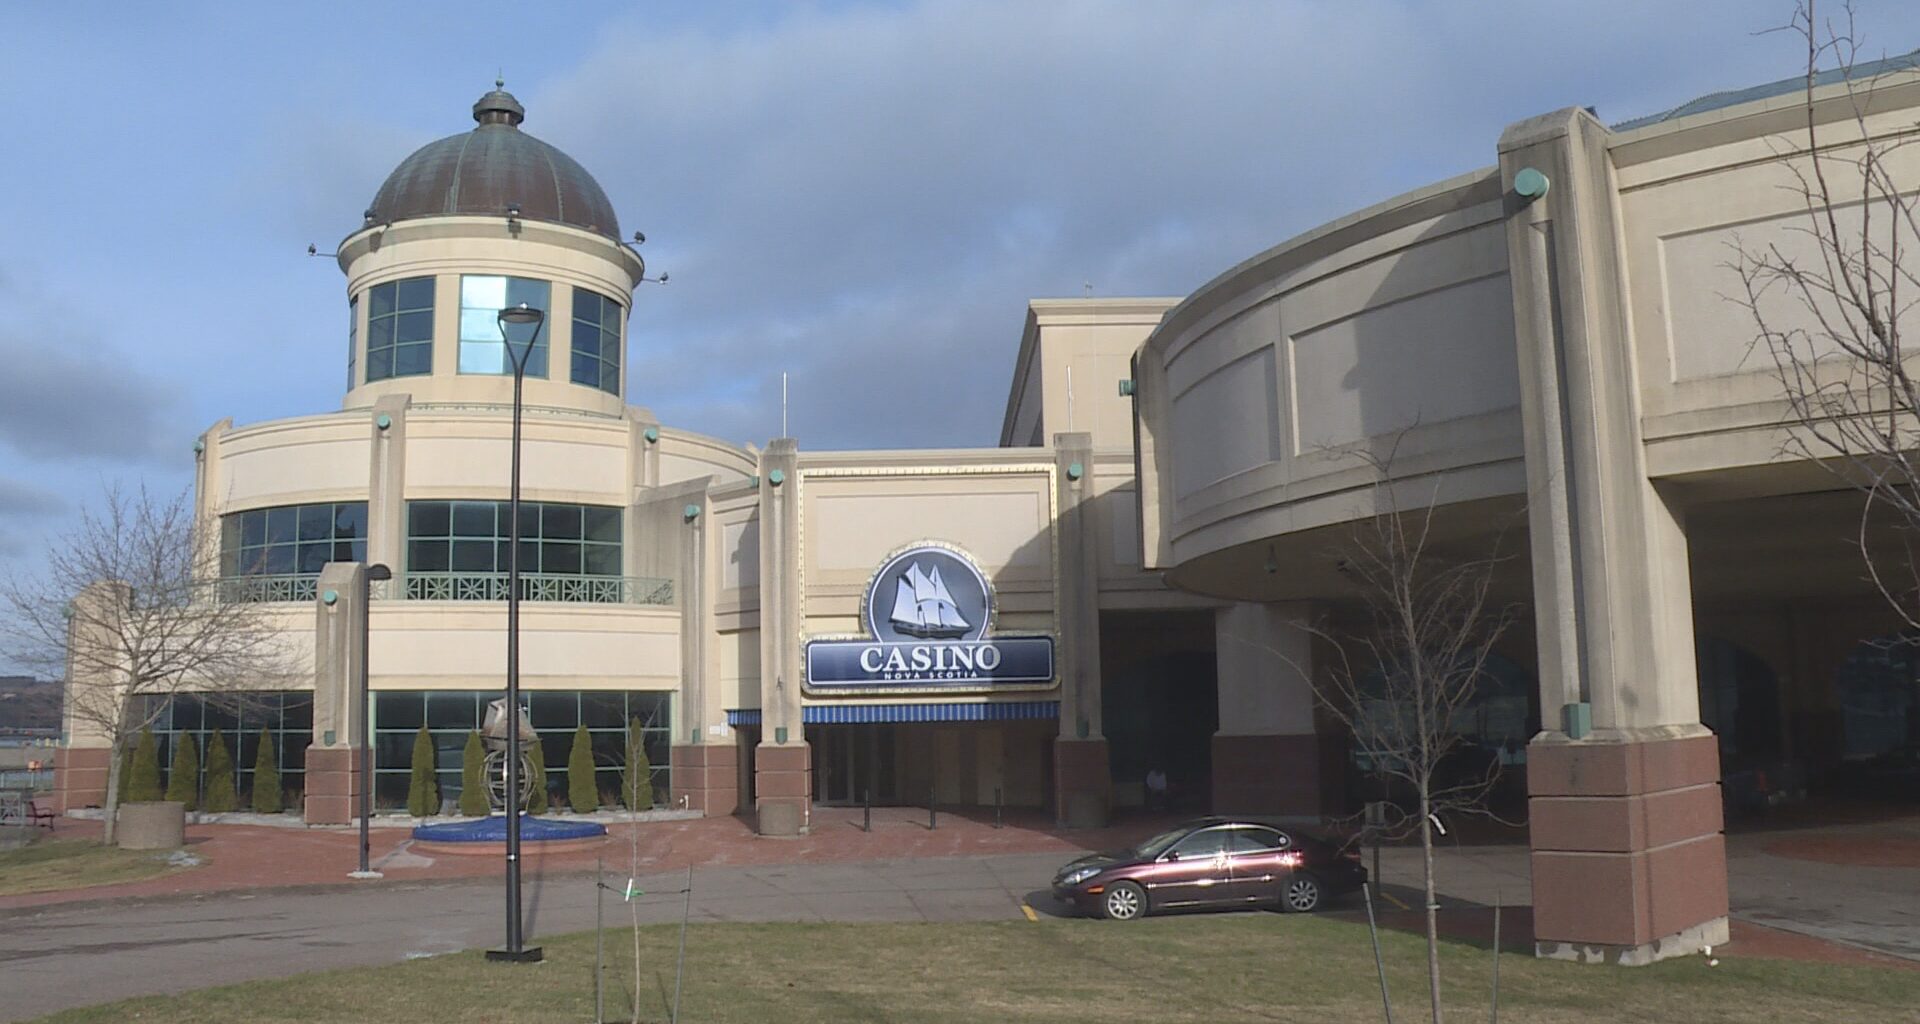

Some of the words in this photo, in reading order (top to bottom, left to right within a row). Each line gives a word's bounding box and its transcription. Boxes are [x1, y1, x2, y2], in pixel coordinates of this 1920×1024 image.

[860, 644, 1001, 672] CASINO
[884, 672, 920, 680] NOVA
[929, 671, 978, 679] SCOTIA
